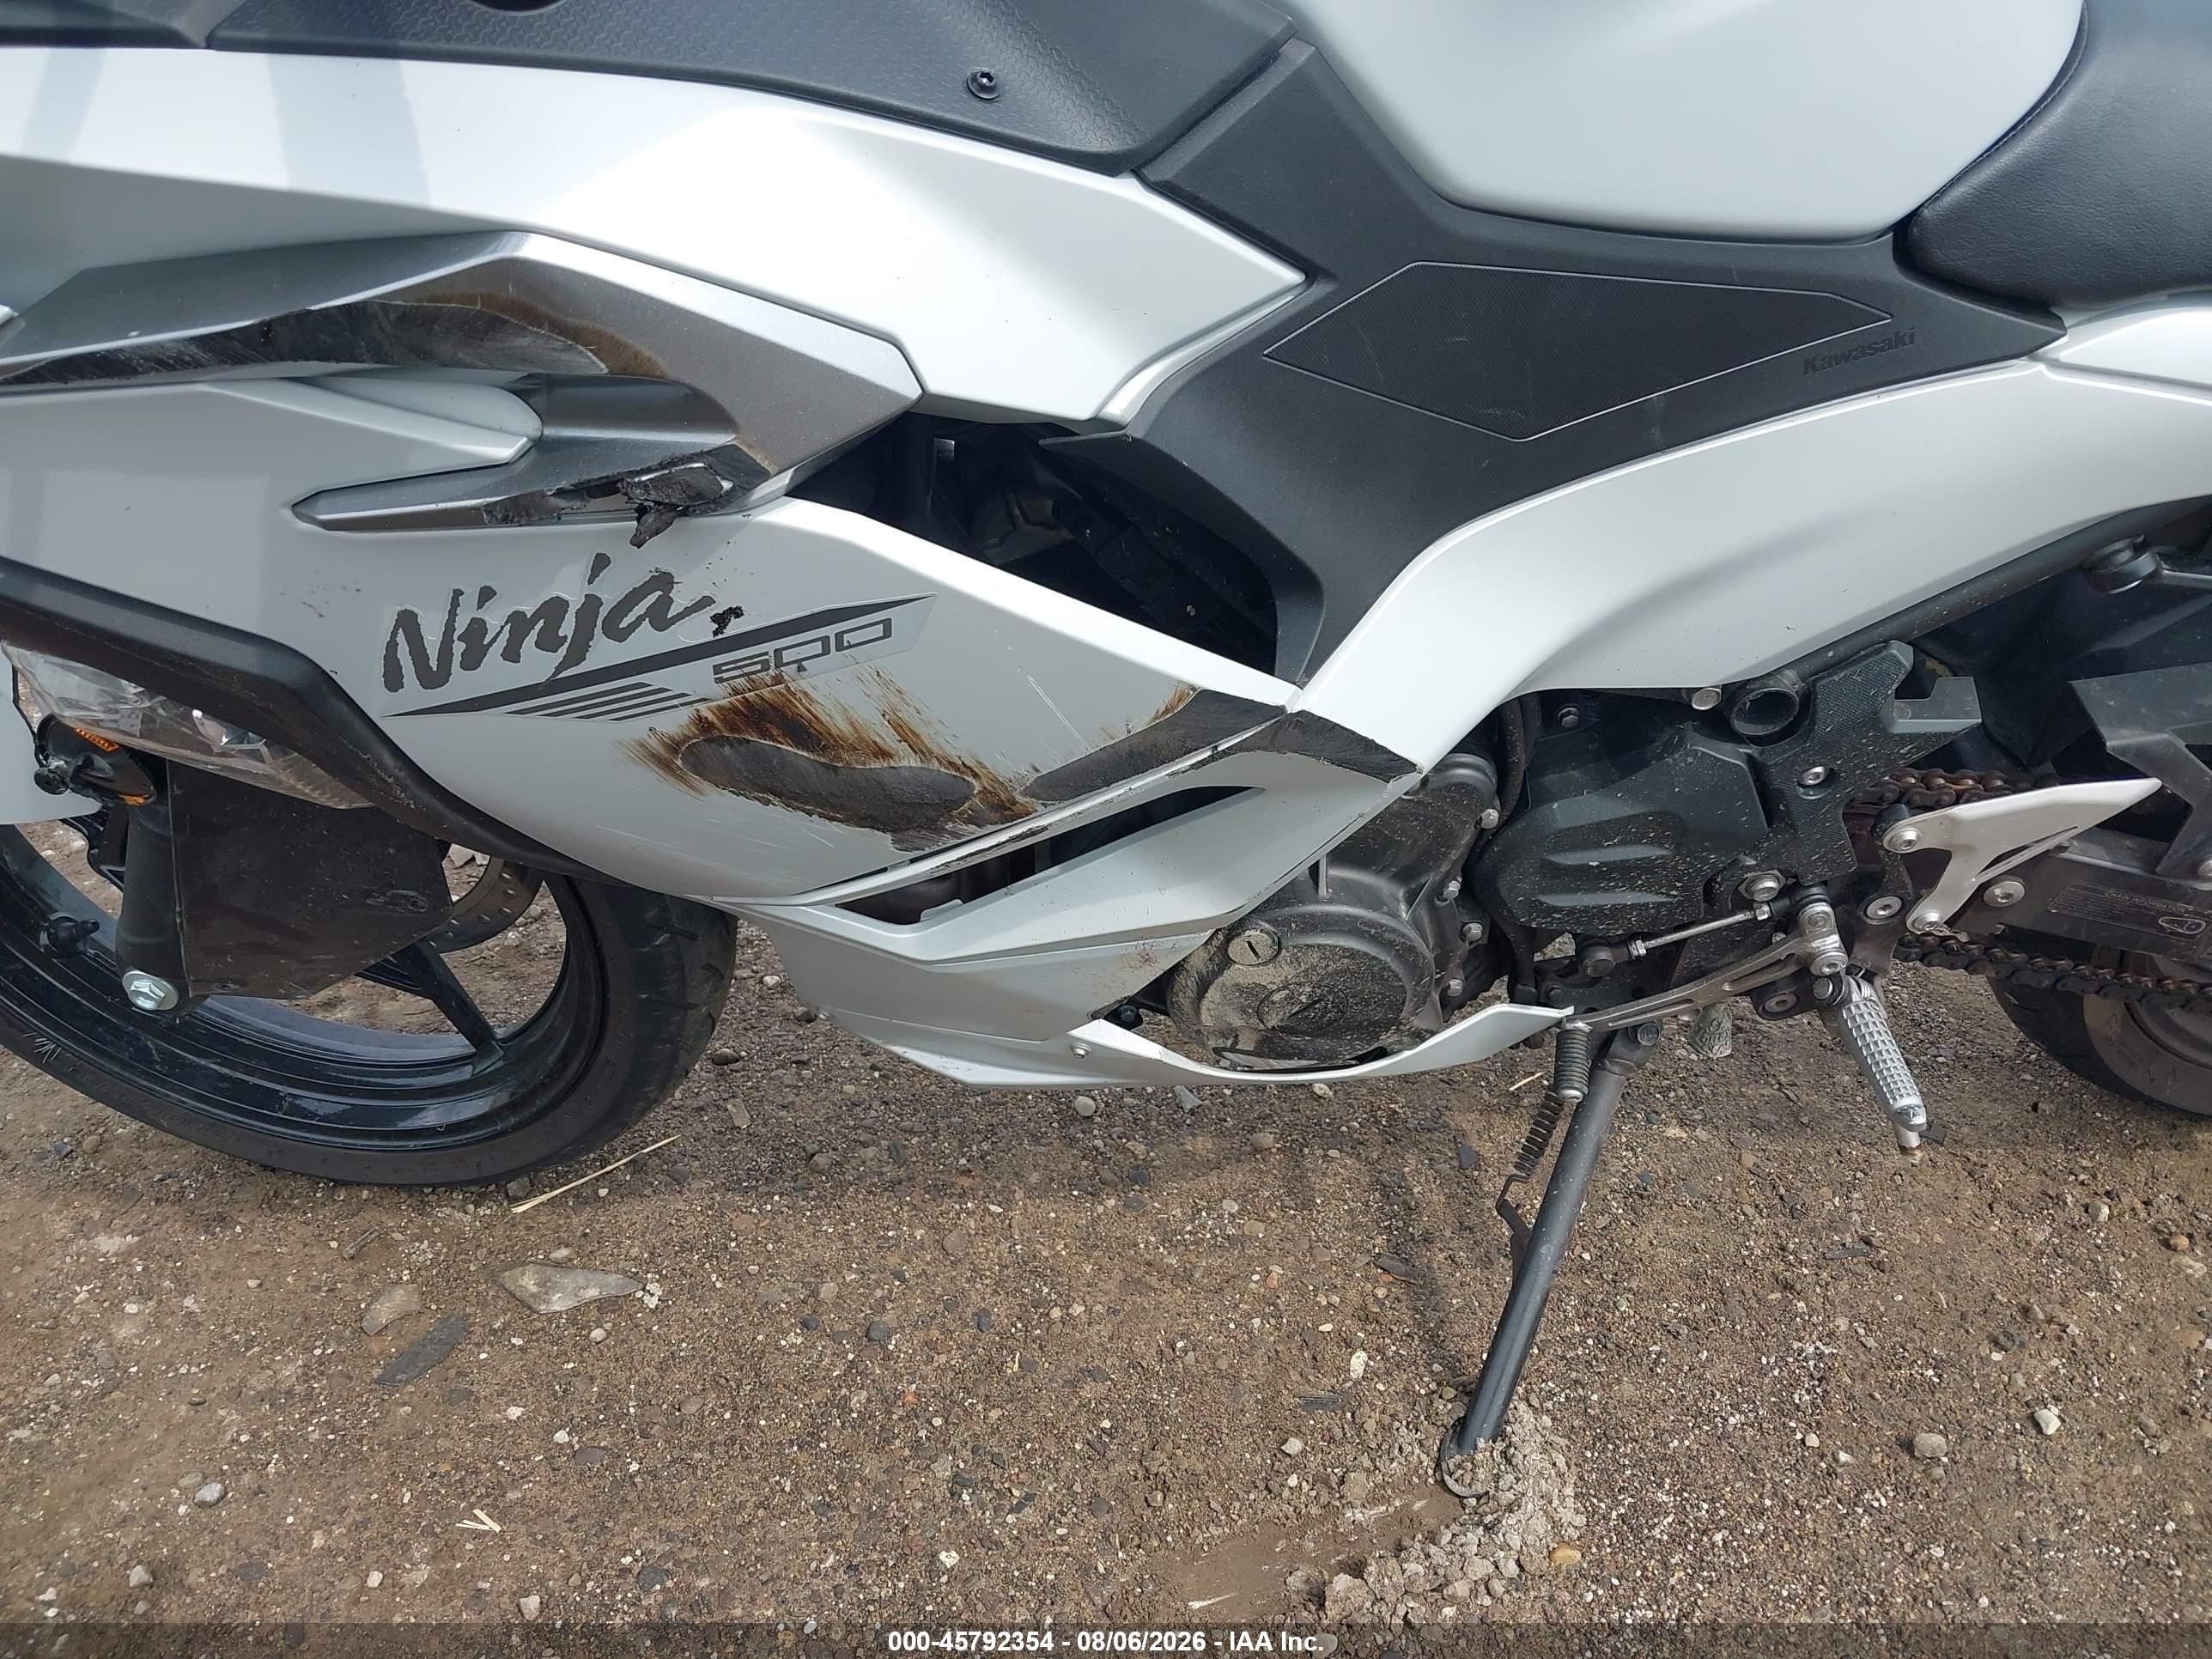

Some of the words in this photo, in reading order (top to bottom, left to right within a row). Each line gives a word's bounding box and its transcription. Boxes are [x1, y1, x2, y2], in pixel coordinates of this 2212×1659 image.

[1802, 326, 1917, 376] Kawasaki
[382, 552, 716, 692] Ninja
[713, 617, 893, 684] 500
